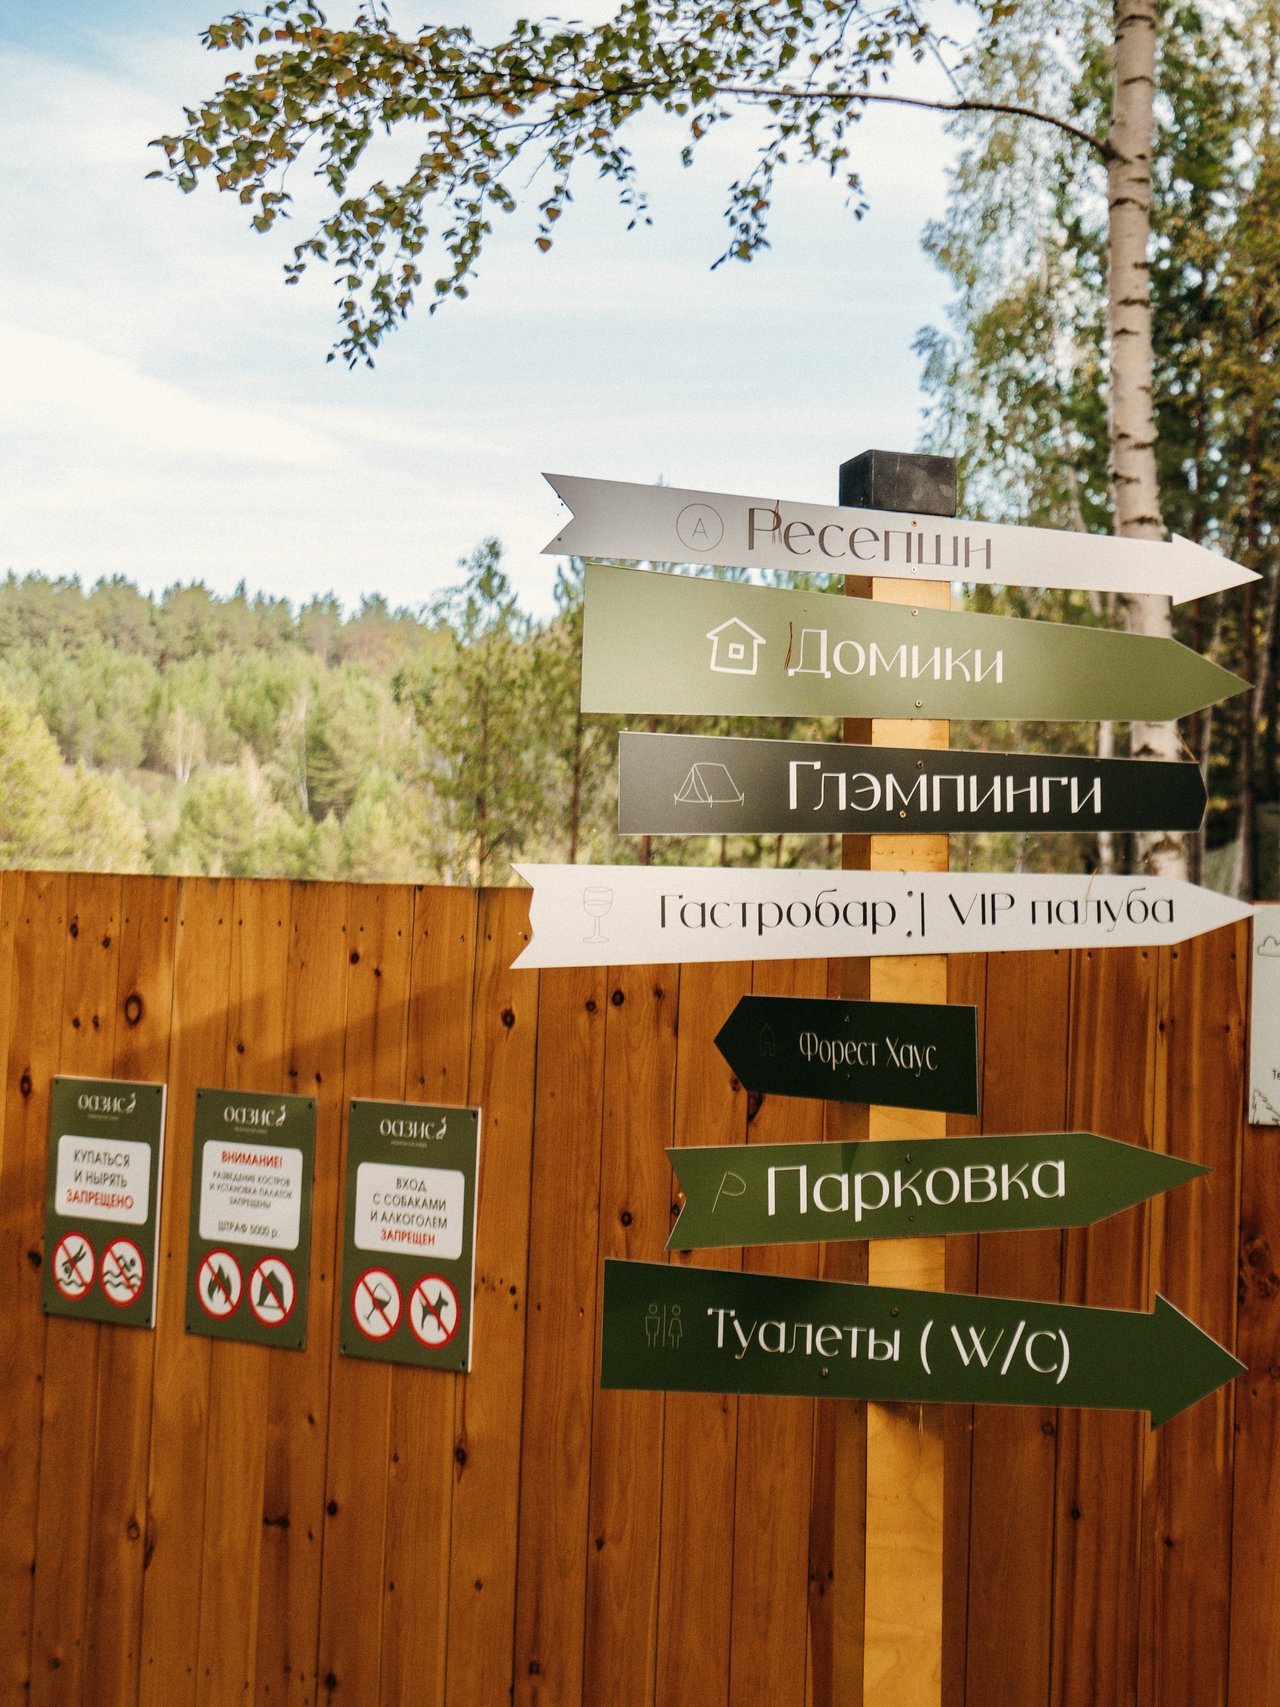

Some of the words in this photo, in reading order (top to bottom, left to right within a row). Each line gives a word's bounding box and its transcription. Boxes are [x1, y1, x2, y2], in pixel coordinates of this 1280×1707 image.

[748, 506, 993, 570] Ресепшн
[788, 628, 1004, 684] Домики
[788, 760, 1102, 815] Глэмпинги
[660, 887, 897, 936] Гастробар
[948, 892, 1016, 926] VIP
[1030, 886, 1174, 936] палуба
[799, 1029, 879, 1070] Форест
[885, 1038, 939, 1077] Хаус
[74, 1149, 130, 1168] КУПАТЬСЯ
[221, 1150, 283, 1169] ВНИМАНИЕ!
[74, 1169, 83, 1183] И
[86, 1171, 127, 1188] НЫРЯТЬ
[396, 1177, 427, 1193] ВХОД
[66, 1189, 134, 1210] ЗАПРЕЩЕНО
[767, 1160, 1066, 1222] Парковка
[373, 1193, 381, 1205] С
[384, 1193, 447, 1211] СОБАКАМИ
[218, 1219, 247, 1233] ШТРАФ
[370, 1210, 379, 1222] И
[381, 1211, 448, 1230] АЛКОГОЛЕМ
[380, 1229, 435, 1246] ЗАПРЕЩЕН
[707, 1307, 901, 1361] Туалеты
